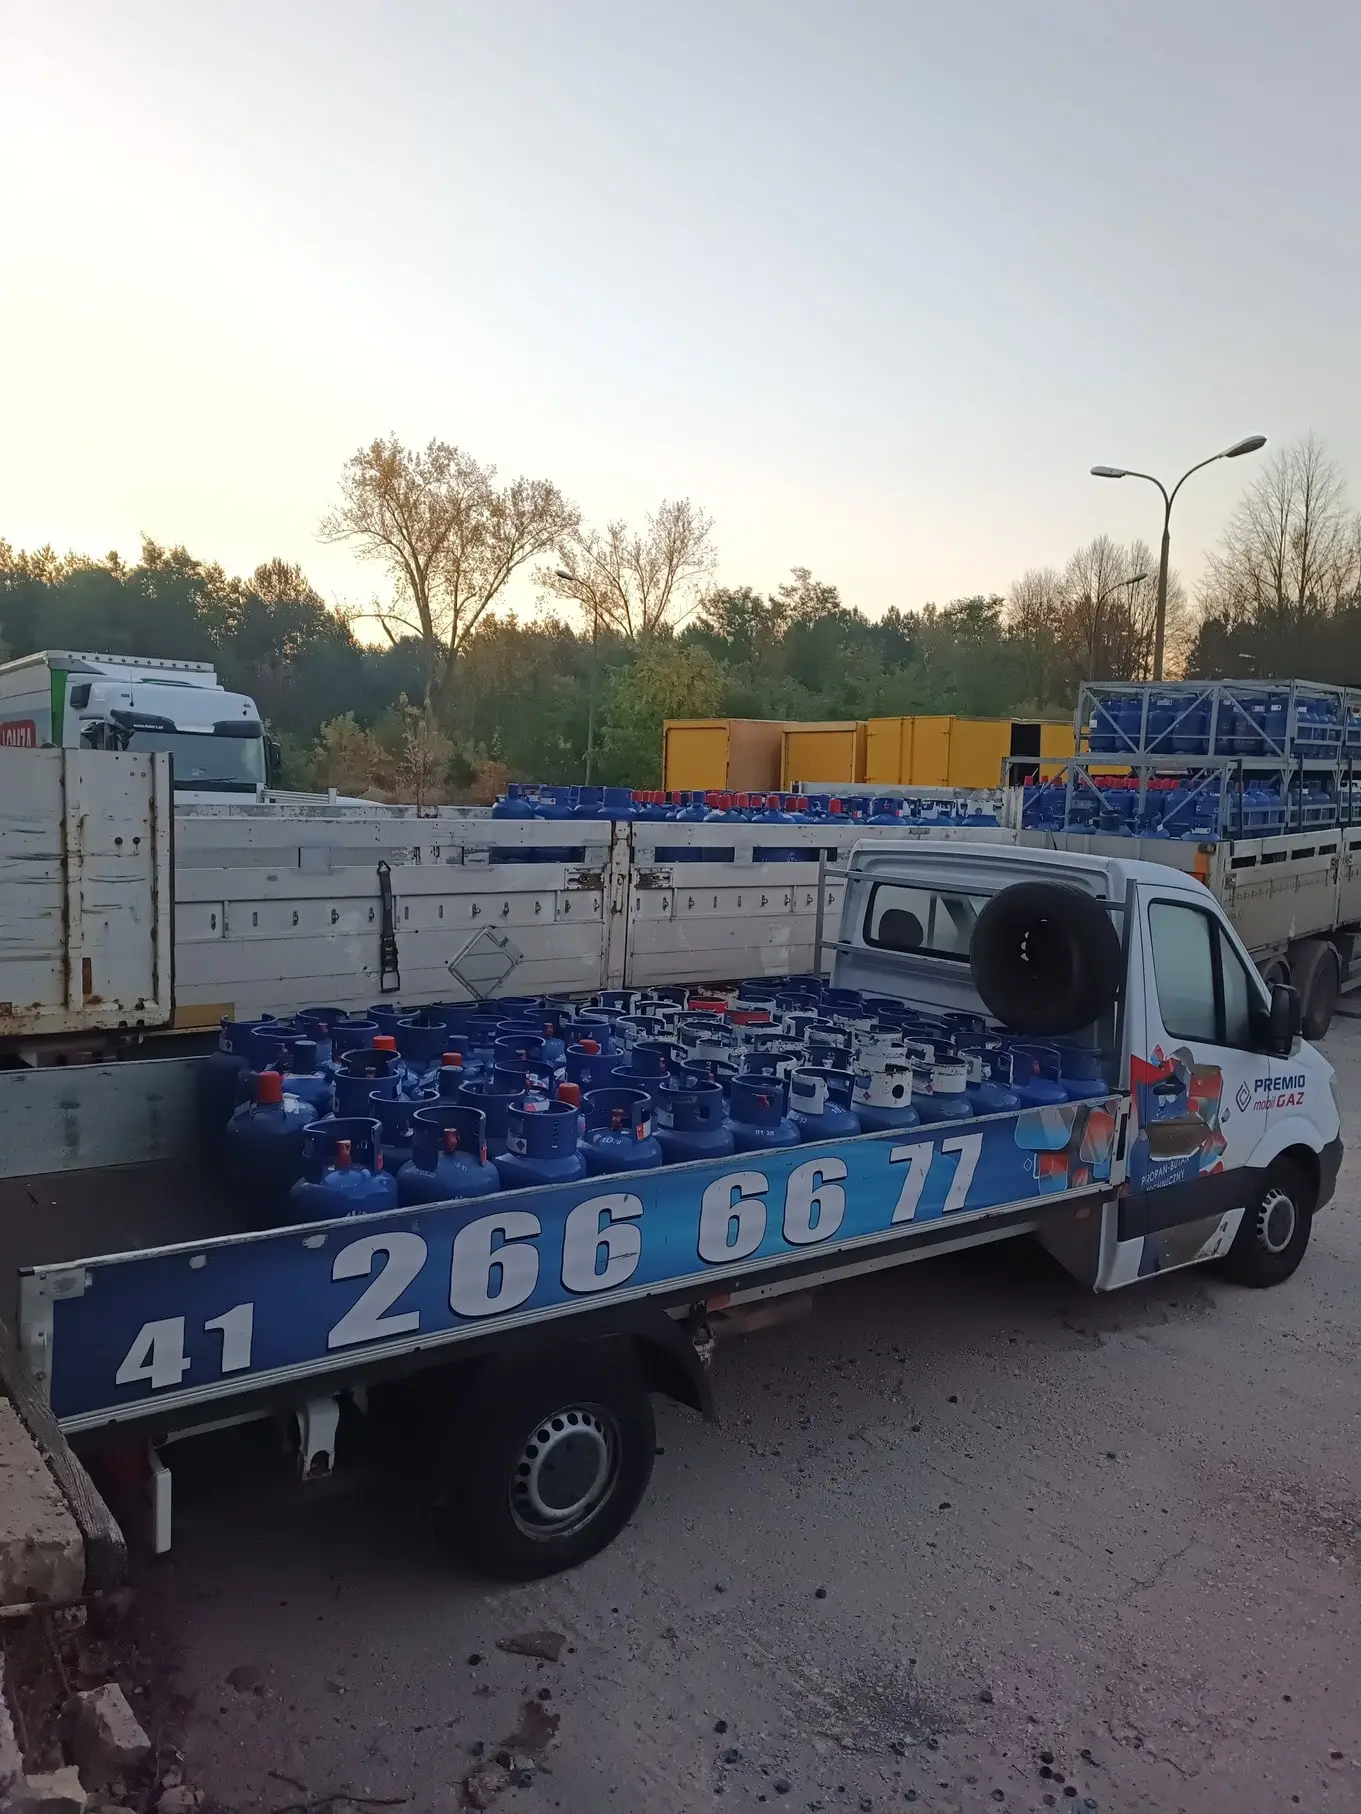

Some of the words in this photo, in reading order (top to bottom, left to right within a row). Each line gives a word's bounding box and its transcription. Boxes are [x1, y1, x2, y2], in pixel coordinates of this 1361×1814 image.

[1254, 1074, 1306, 1093] PREMIO
[115, 1302, 255, 1389] 41
[327, 1192, 645, 1349] 266
[696, 1156, 849, 1264] 66
[888, 1132, 984, 1226] 77
